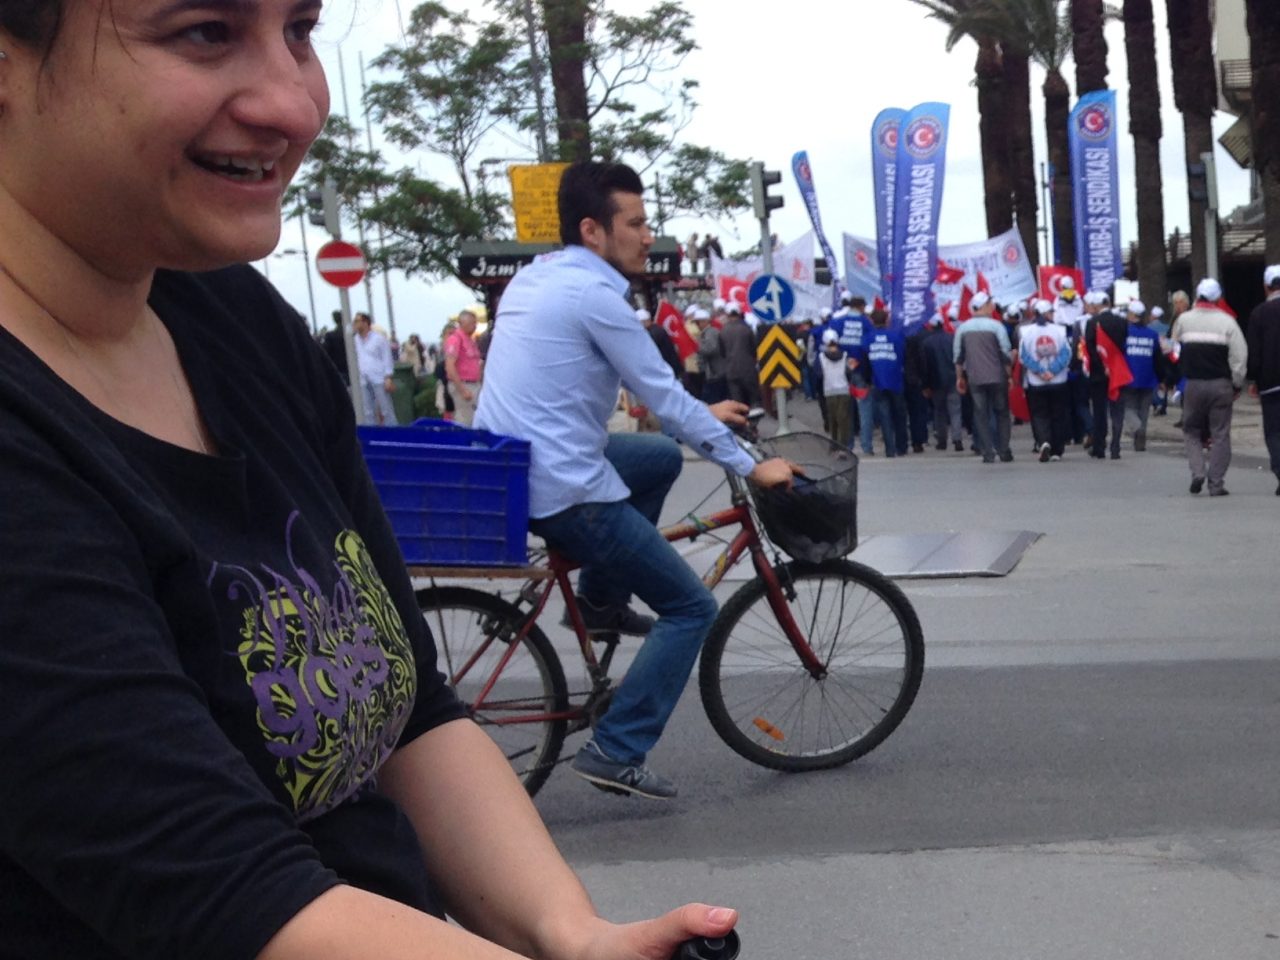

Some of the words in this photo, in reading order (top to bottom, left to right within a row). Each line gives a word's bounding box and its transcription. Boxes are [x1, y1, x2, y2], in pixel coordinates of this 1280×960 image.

[904, 162, 936, 233] SENDİKASI
[1081, 147, 1112, 215] SENDİKASI
[469, 257, 523, 277] İzmi
